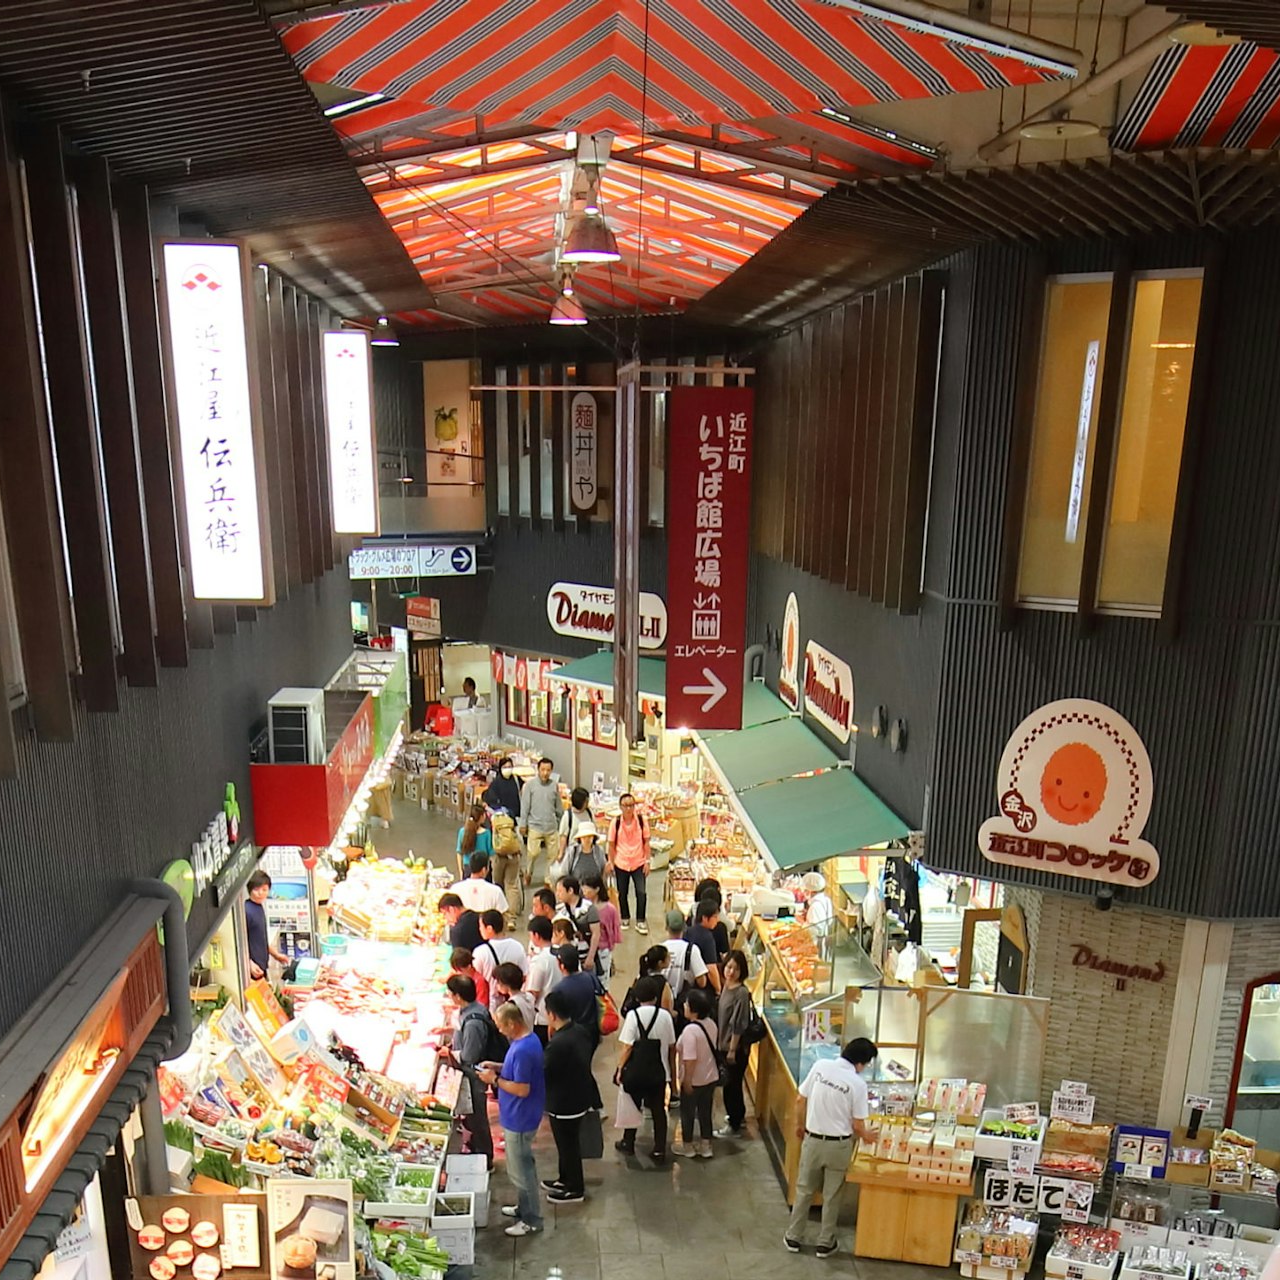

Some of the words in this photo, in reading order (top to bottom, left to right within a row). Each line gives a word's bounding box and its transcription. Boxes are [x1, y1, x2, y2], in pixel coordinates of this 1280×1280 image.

[728, 411, 748, 474] 近江町
[694, 414, 724, 588] いちば館広場
[674, 645, 737, 658] エレベーター
[1004, 795, 1034, 829] 金沢
[988, 831, 1131, 873] 近江町コロッケ
[1070, 944, 1166, 982] Diamond
[814, 1071, 850, 1095] Diamond
[986, 1178, 1064, 1210] ほたて
